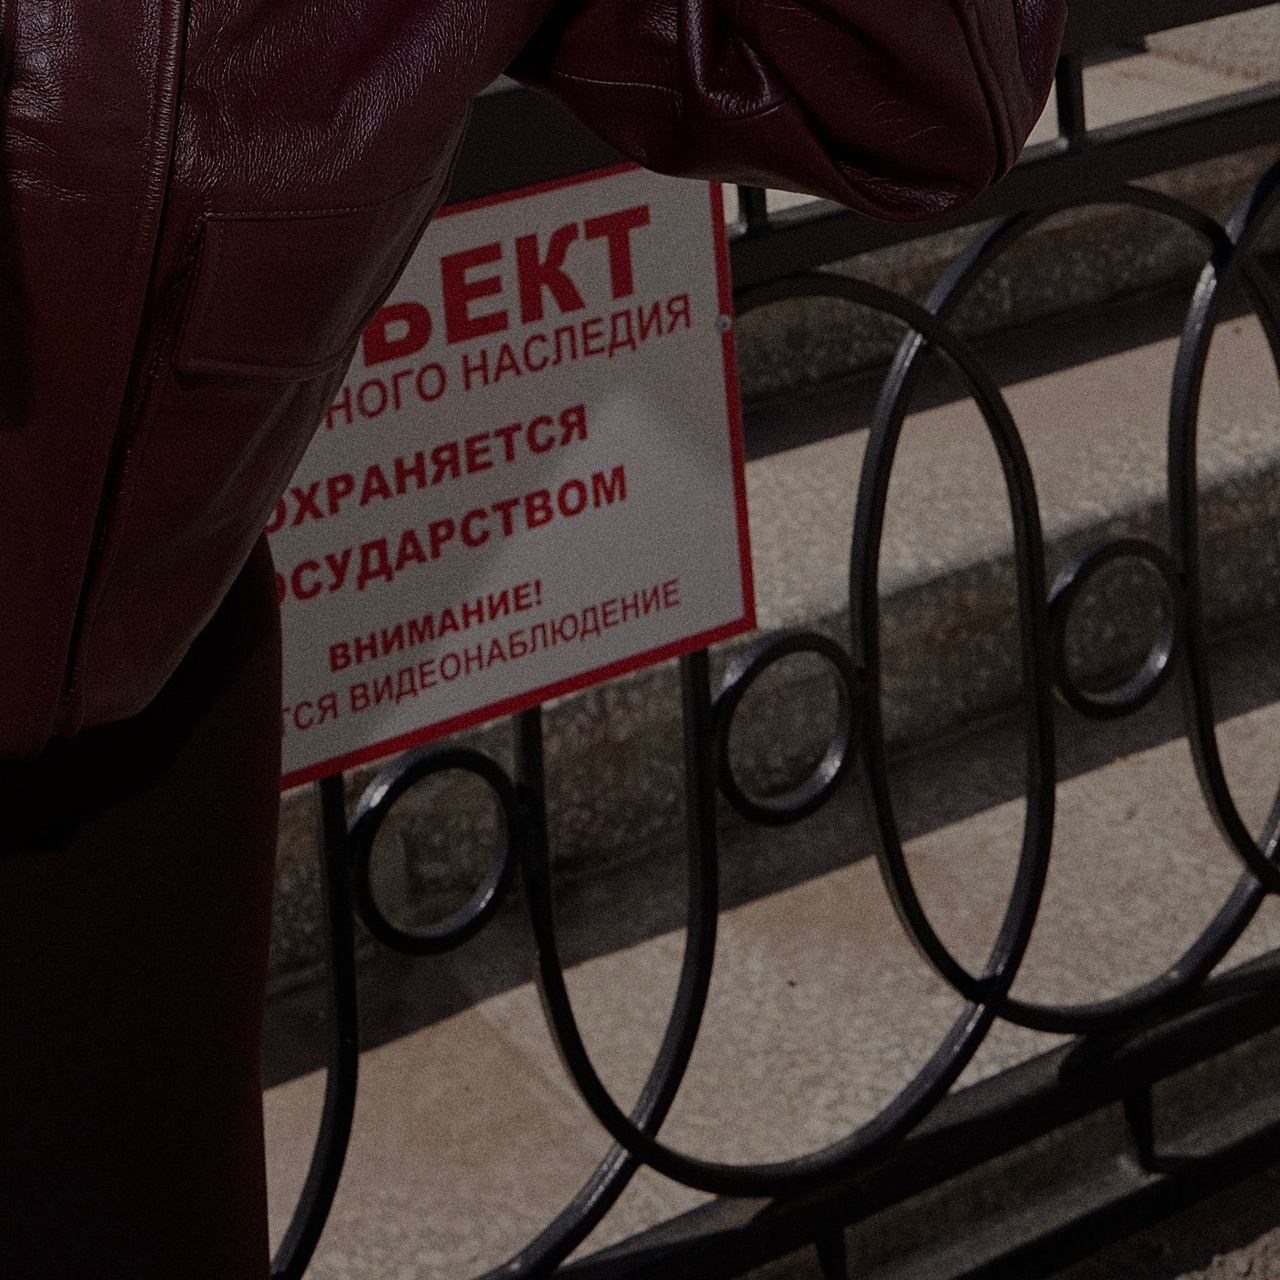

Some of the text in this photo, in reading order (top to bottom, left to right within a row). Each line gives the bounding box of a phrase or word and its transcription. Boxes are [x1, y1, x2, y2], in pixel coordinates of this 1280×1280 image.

[462, 294, 692, 391] НАСЛЕДИЯ
[329, 580, 543, 673] ВНИМАНИЕ!
[350, 579, 681, 715] ВИДЕОНАБЛЮДЕНИЕ
